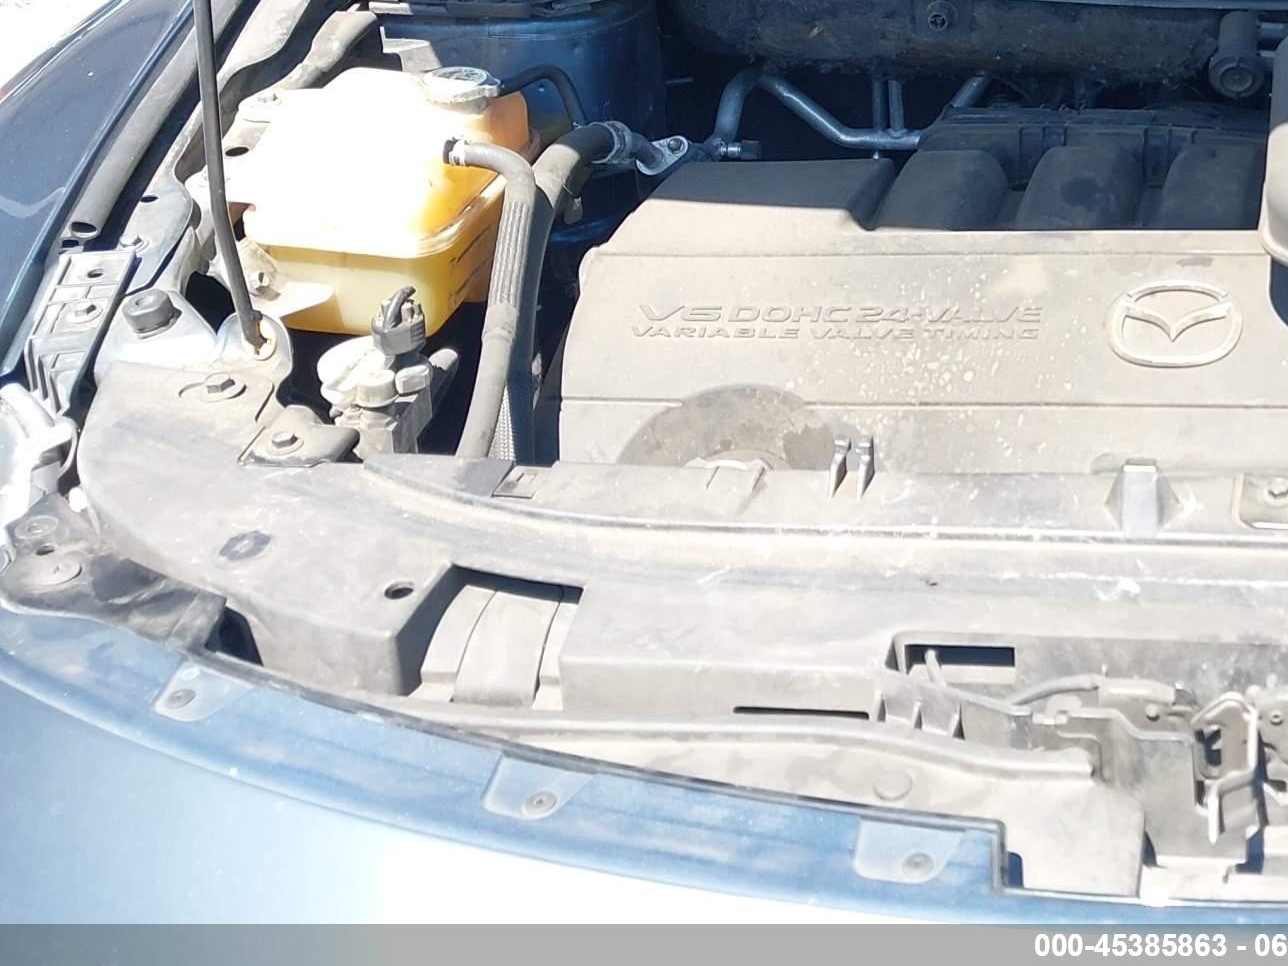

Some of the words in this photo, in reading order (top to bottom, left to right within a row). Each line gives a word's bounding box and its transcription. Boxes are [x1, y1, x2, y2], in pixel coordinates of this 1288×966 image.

[639, 304, 722, 321] V6
[727, 305, 852, 323] DOHC
[855, 306, 1043, 323] 24-VALVE
[631, 325, 800, 339] VARIABLE
[810, 326, 915, 340] VALVE
[923, 328, 1041, 340] TIMING
